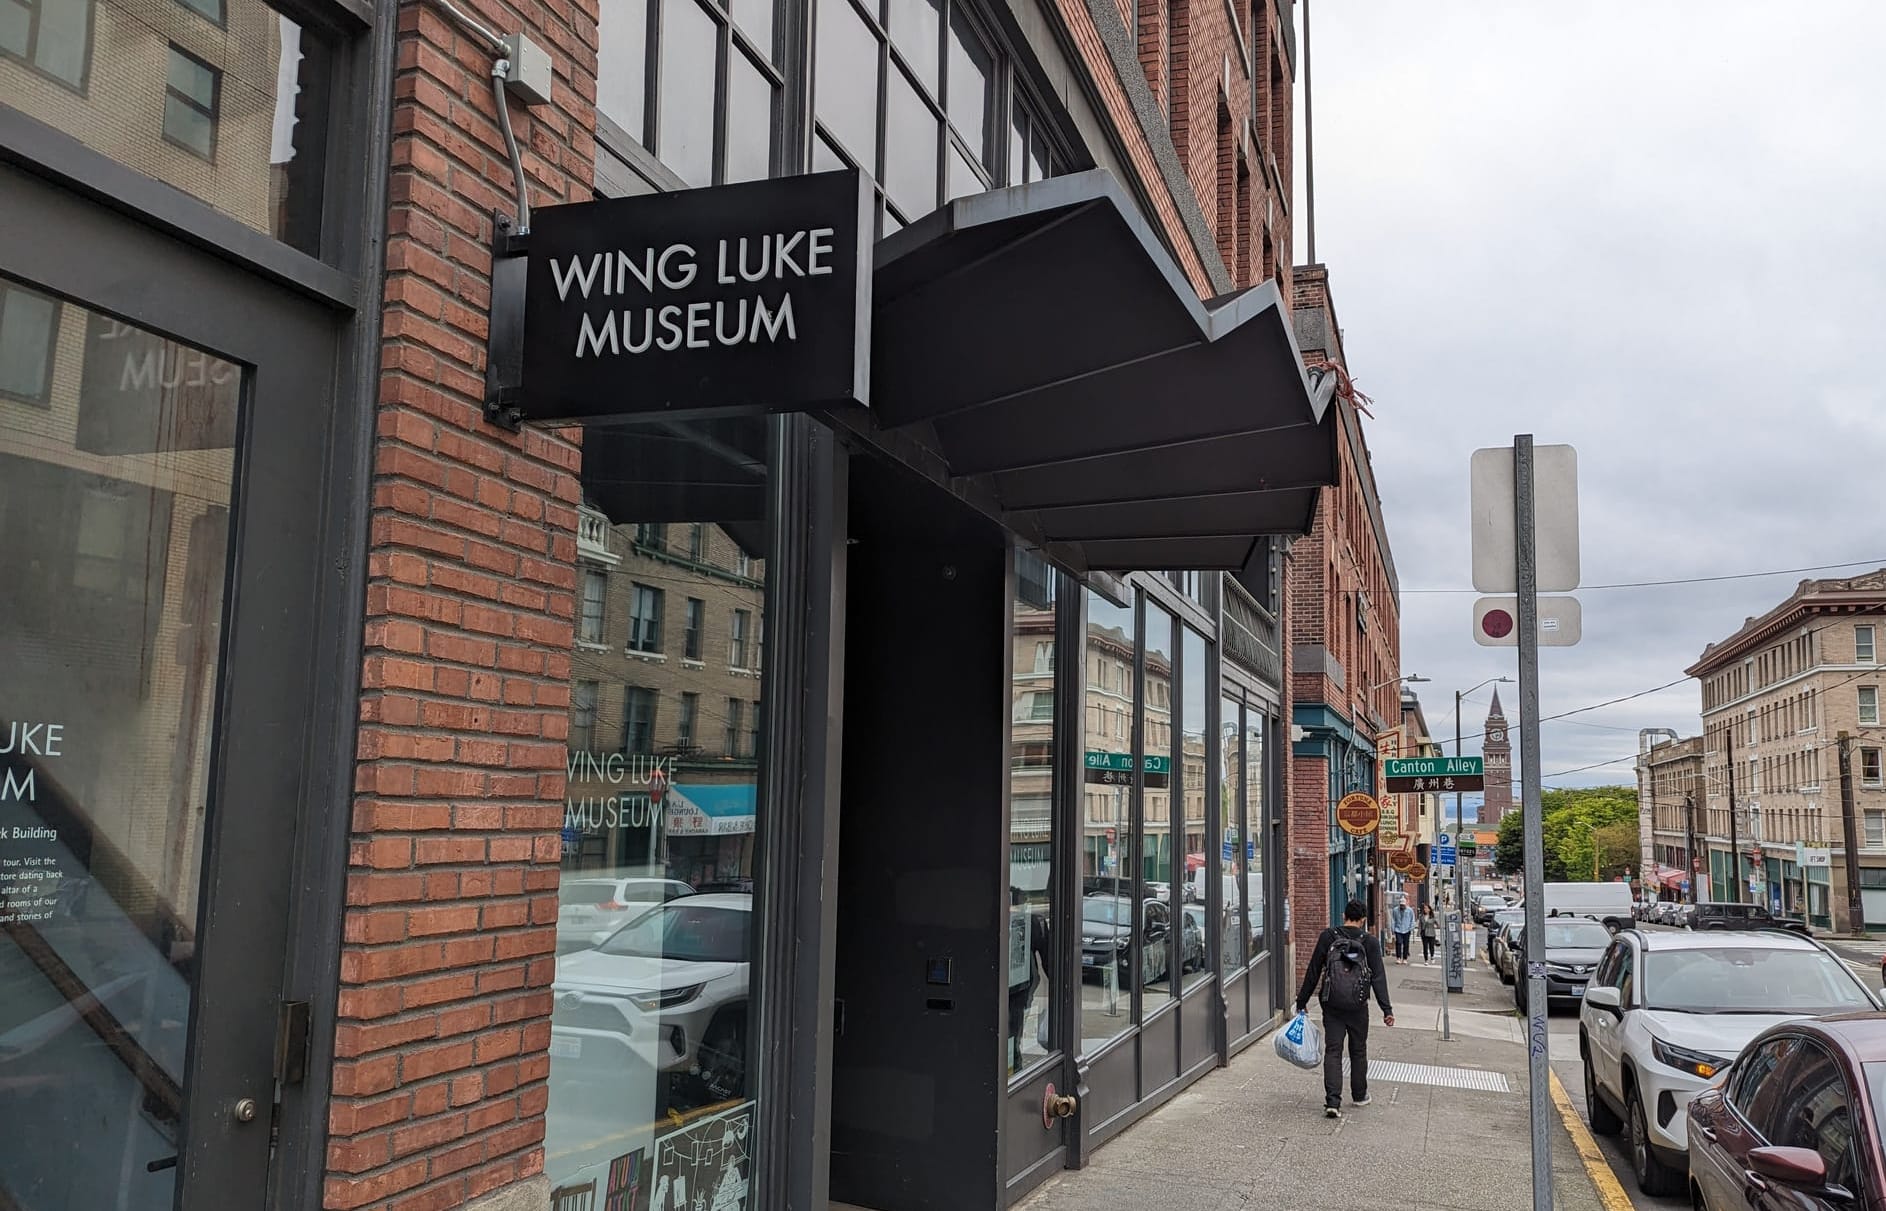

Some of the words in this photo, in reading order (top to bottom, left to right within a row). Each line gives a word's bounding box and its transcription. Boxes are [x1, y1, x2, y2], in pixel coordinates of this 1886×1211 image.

[549, 243, 698, 301] WING
[717, 227, 834, 285] LUKE
[575, 291, 797, 358] MUSEUM
[0, 720, 64, 757] UKE
[631, 754, 678, 786] LUKE
[1391, 760, 1435, 774] Canton
[1446, 759, 1477, 775] Alley
[565, 796, 664, 829] MUSEUM
[12, 826, 57, 841] Building
[3, 858, 21, 867] tour.
[24, 857, 41, 866] Visit
[43, 857, 56, 865] the
[0, 872, 16, 881] tore
[19, 870, 43, 881] dating
[46, 869, 63, 879] back
[1, 885, 19, 895] altar
[22, 884, 32, 894] of
[7, 900, 31, 908] rooms
[33, 897, 43, 906] of
[44, 898, 57, 906] our
[16, 911, 42, 921] stories
[44, 910, 54, 919] of
